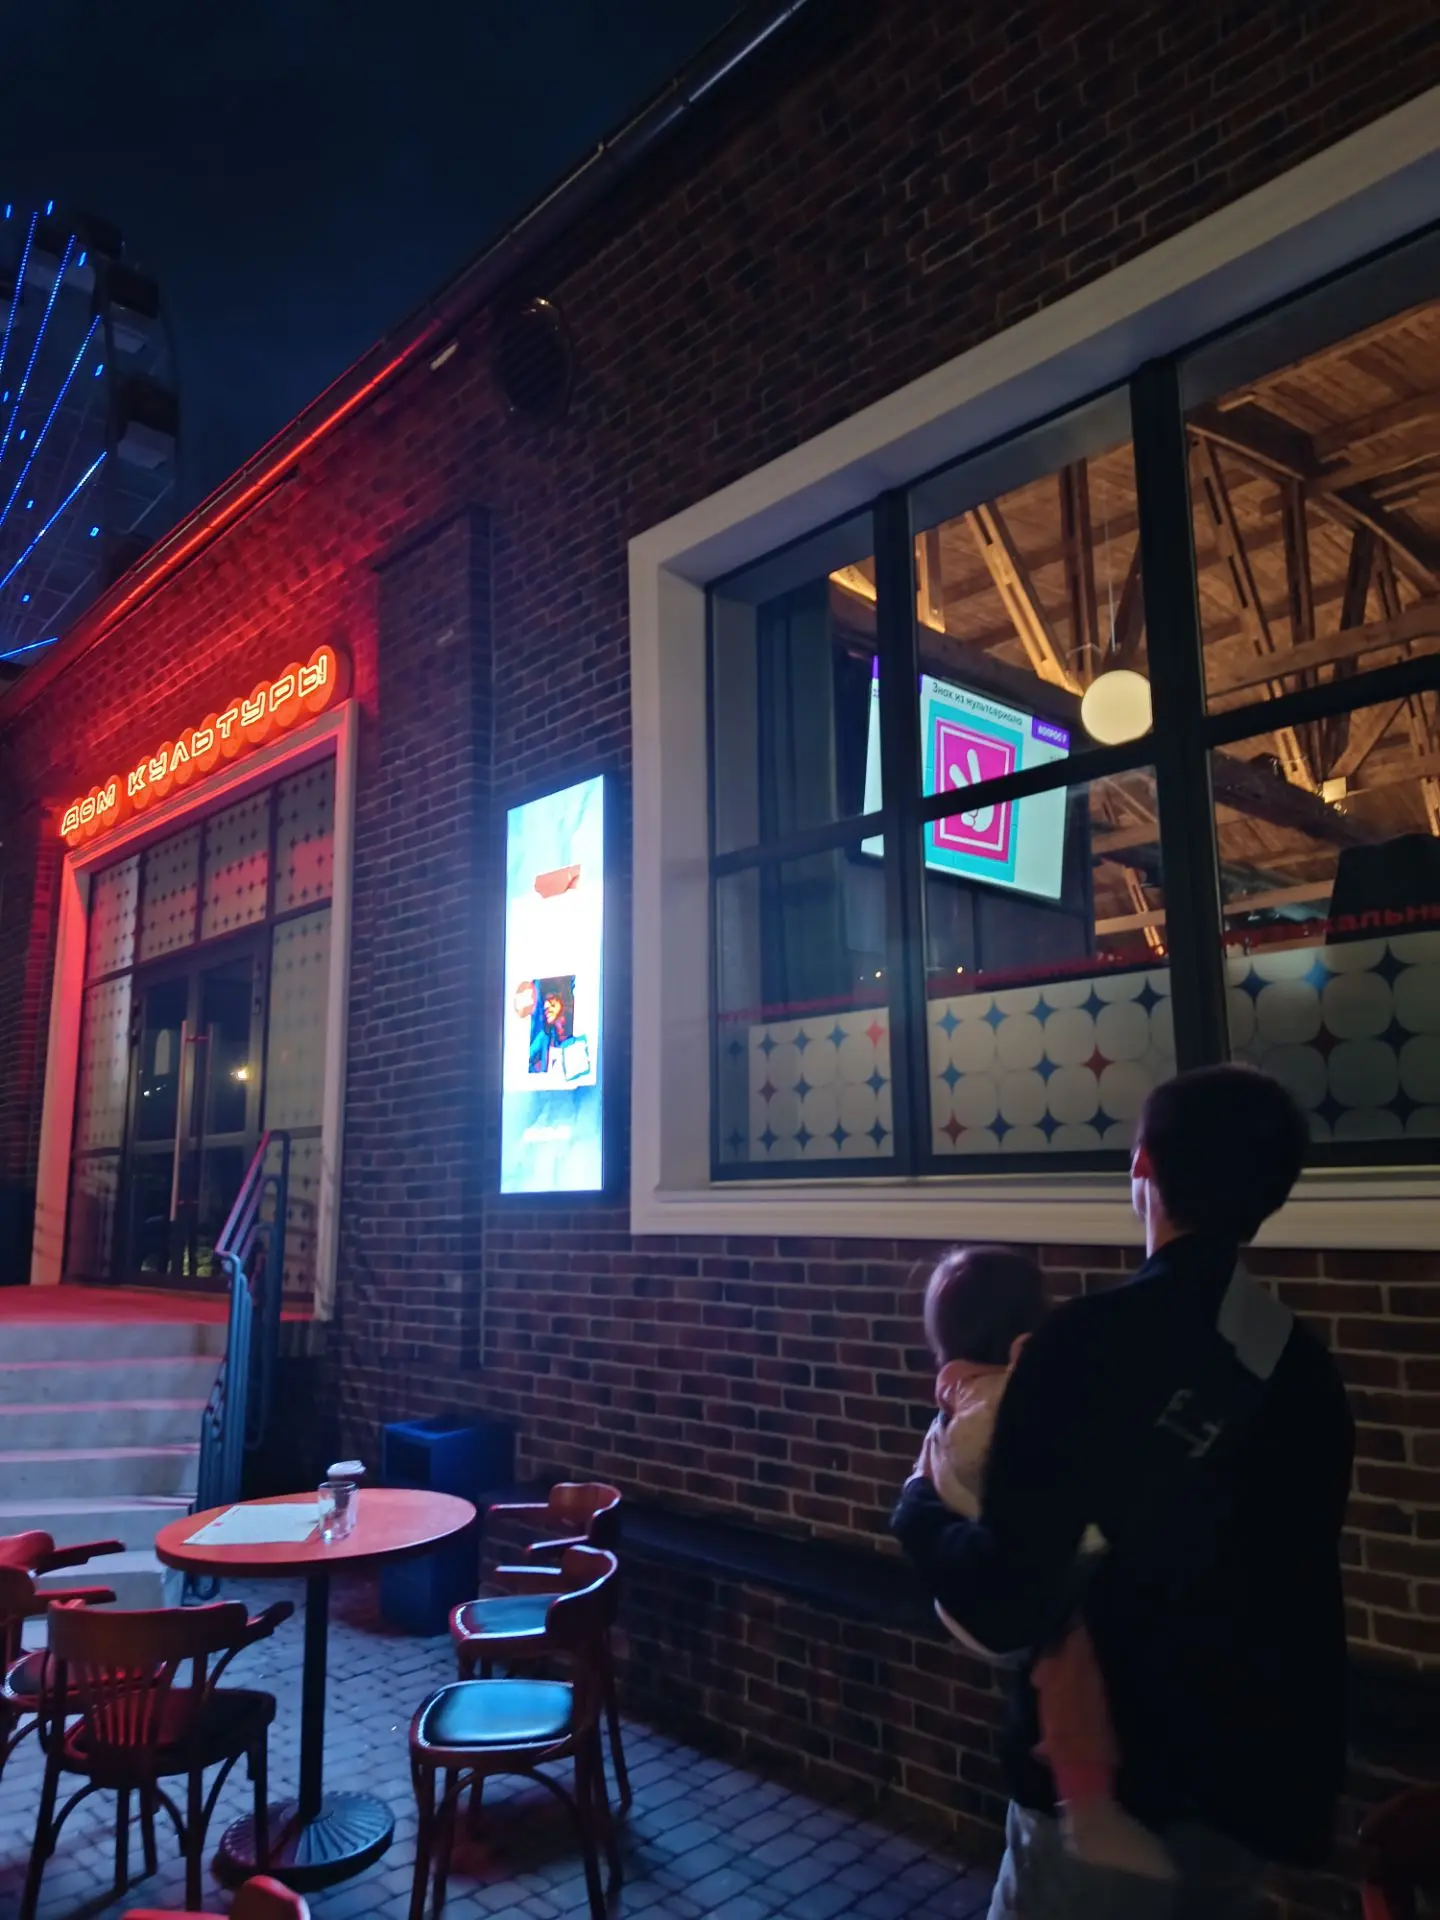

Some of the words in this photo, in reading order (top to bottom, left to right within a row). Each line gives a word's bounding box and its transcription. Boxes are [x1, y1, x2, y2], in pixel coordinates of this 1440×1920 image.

[932, 682, 954, 699] Знак
[954, 693, 965, 704] из
[61, 784, 116, 836] ДОМ
[127, 654, 328, 797] КУЛЬТУРЫ
